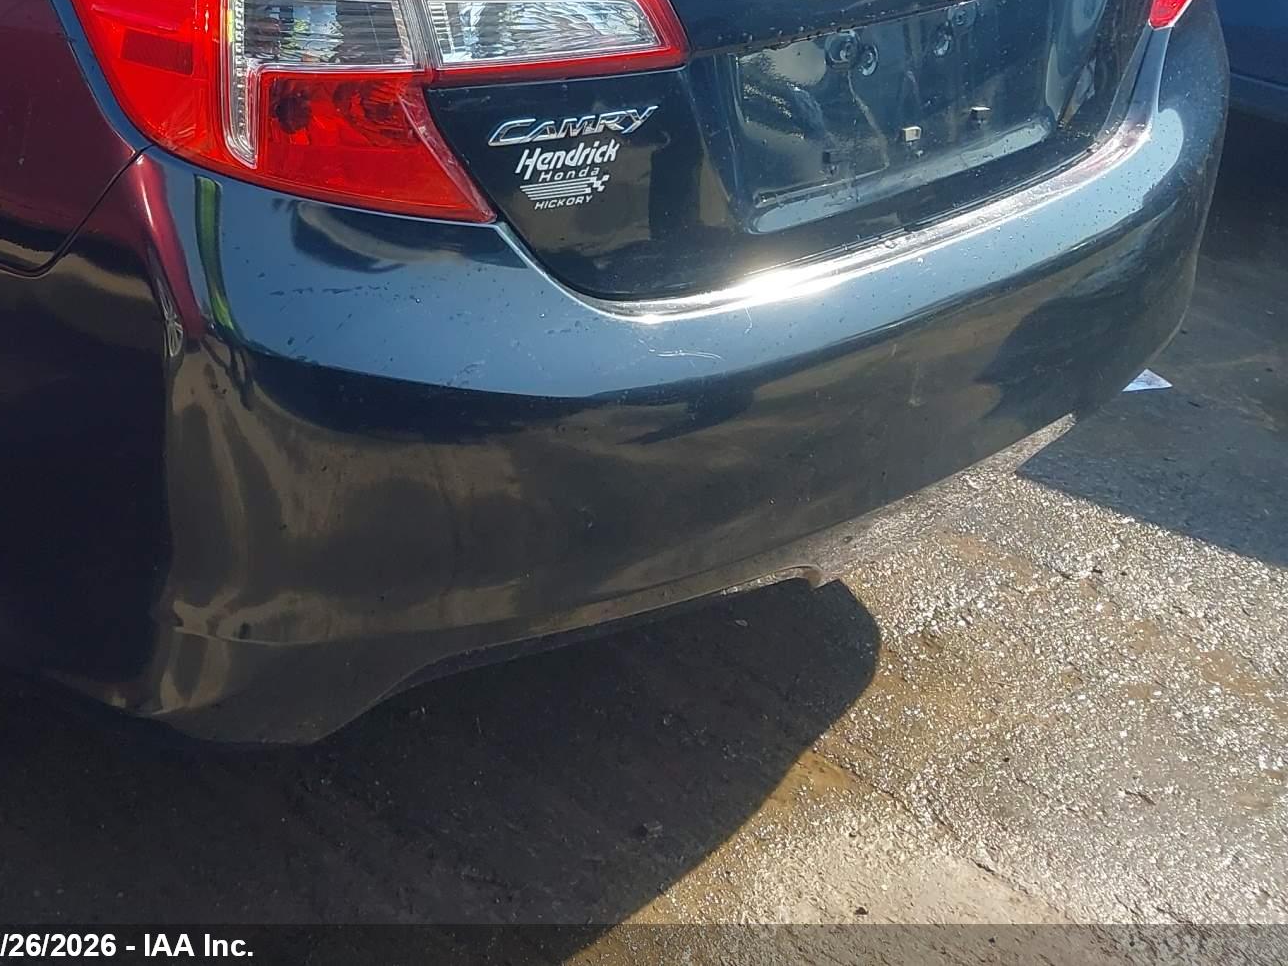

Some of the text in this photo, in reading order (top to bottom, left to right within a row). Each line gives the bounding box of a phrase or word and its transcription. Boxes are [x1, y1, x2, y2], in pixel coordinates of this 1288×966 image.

[488, 105, 659, 147] CAMRY
[514, 138, 621, 181] Hendrick
[538, 166, 601, 183] Honda
[534, 194, 593, 211] HICKORY
